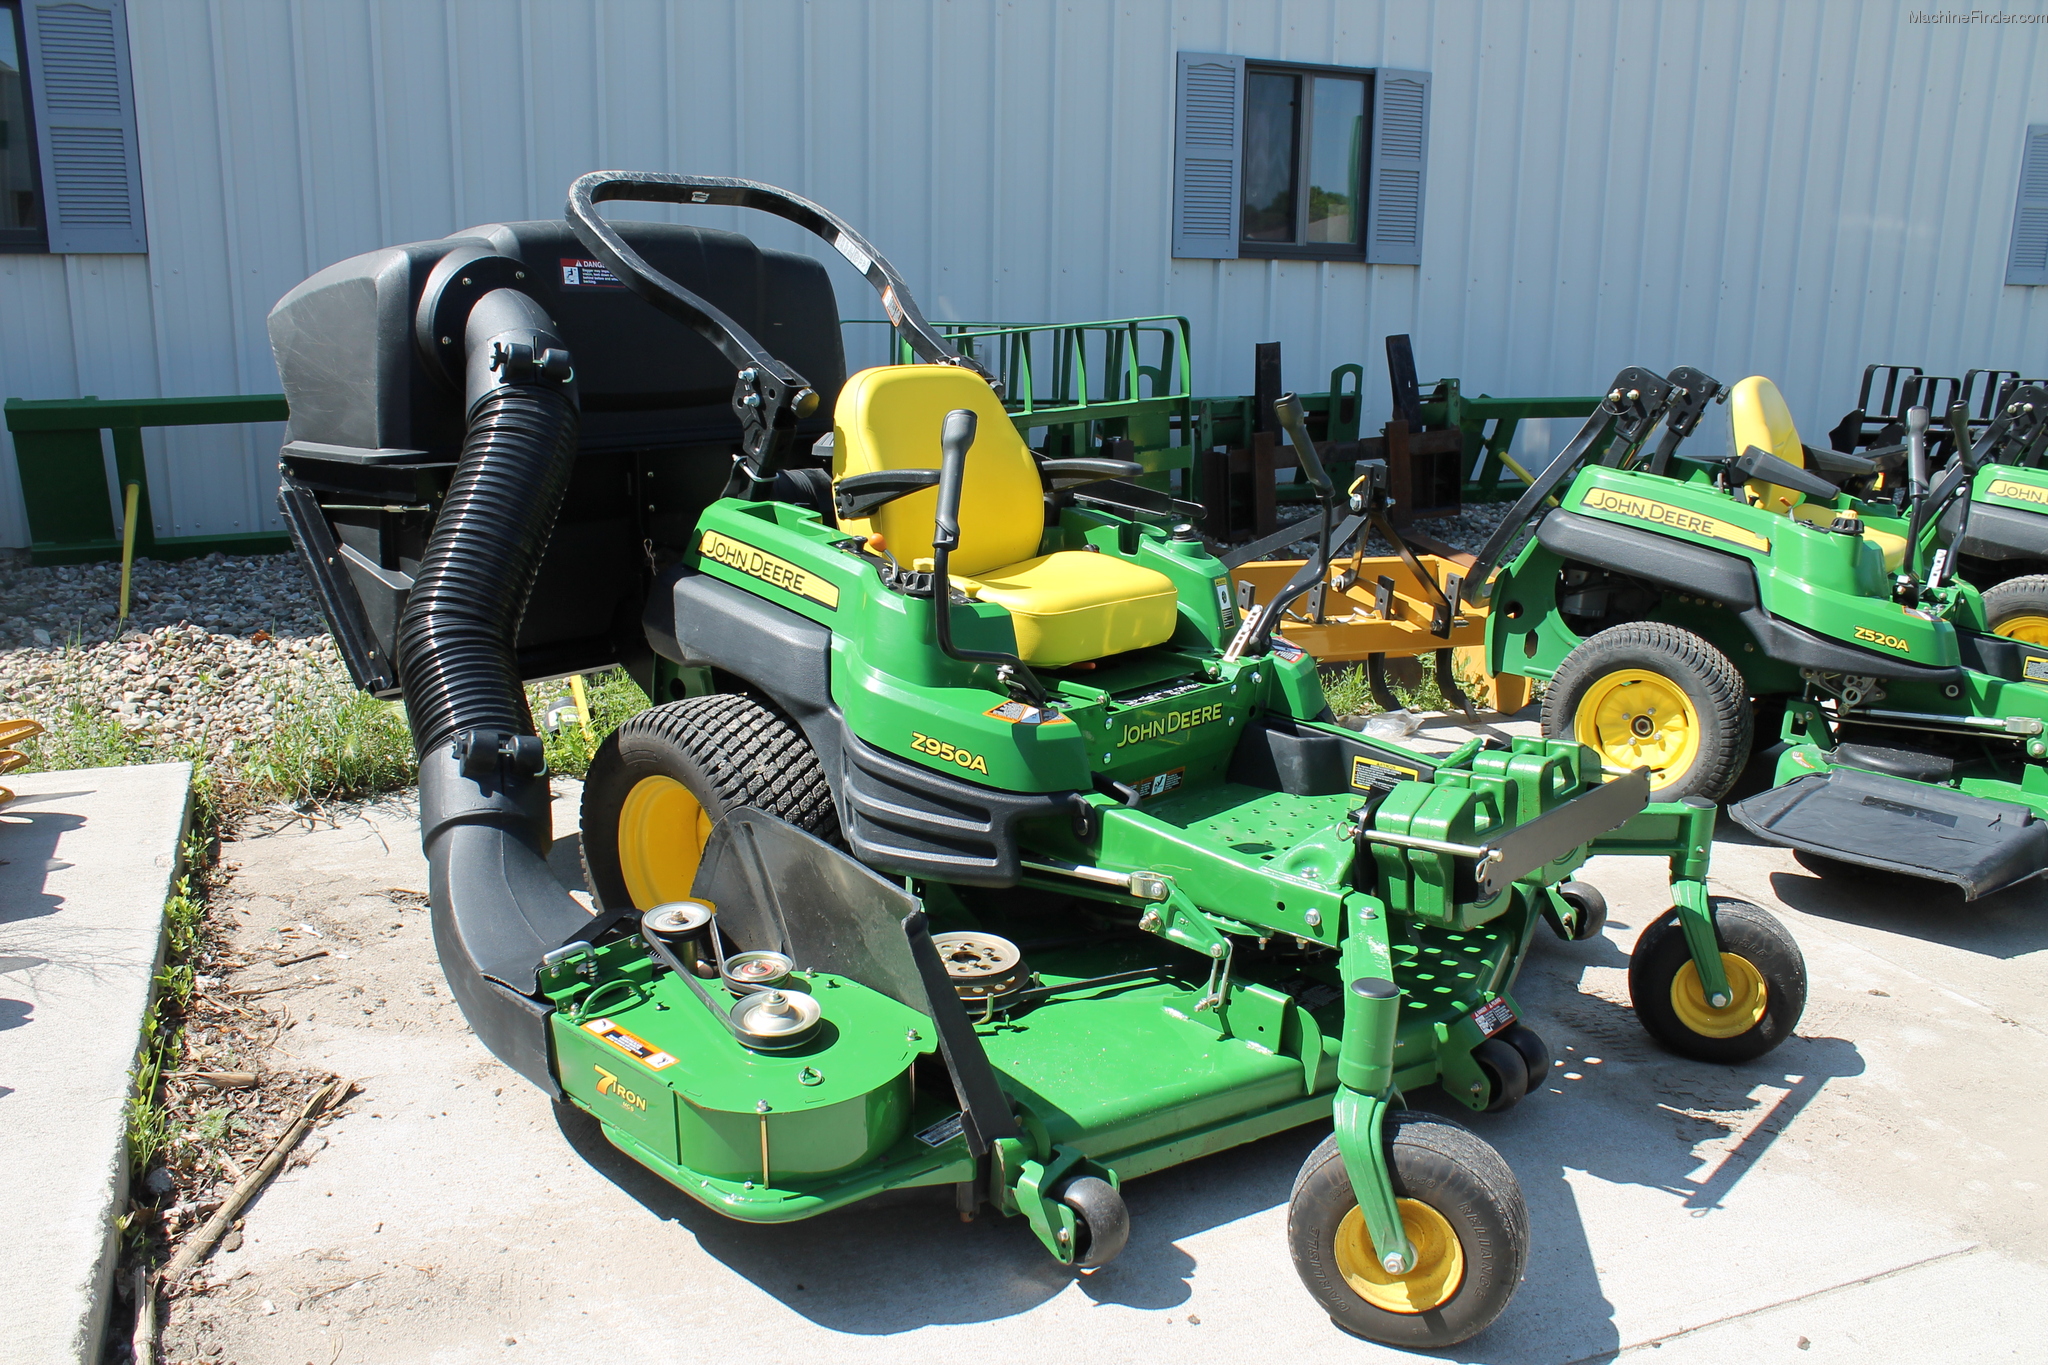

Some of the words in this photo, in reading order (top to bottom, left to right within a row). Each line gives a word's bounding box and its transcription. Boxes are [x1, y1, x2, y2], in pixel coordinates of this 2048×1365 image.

[583, 260, 606, 268] DANG
[1996, 483, 2043, 501] JOHN
[1593, 493, 1645, 517] JOHN
[1649, 504, 1715, 535] DEERE
[706, 537, 748, 568] JOHN
[749, 552, 806, 591] DEERE
[1853, 626, 1910, 653] Z520A
[1117, 718, 1165, 748] JOHN
[1167, 702, 1223, 734] DEERE
[910, 731, 989, 776] Z950A
[1457, 1201, 1493, 1300] RELIANCE
